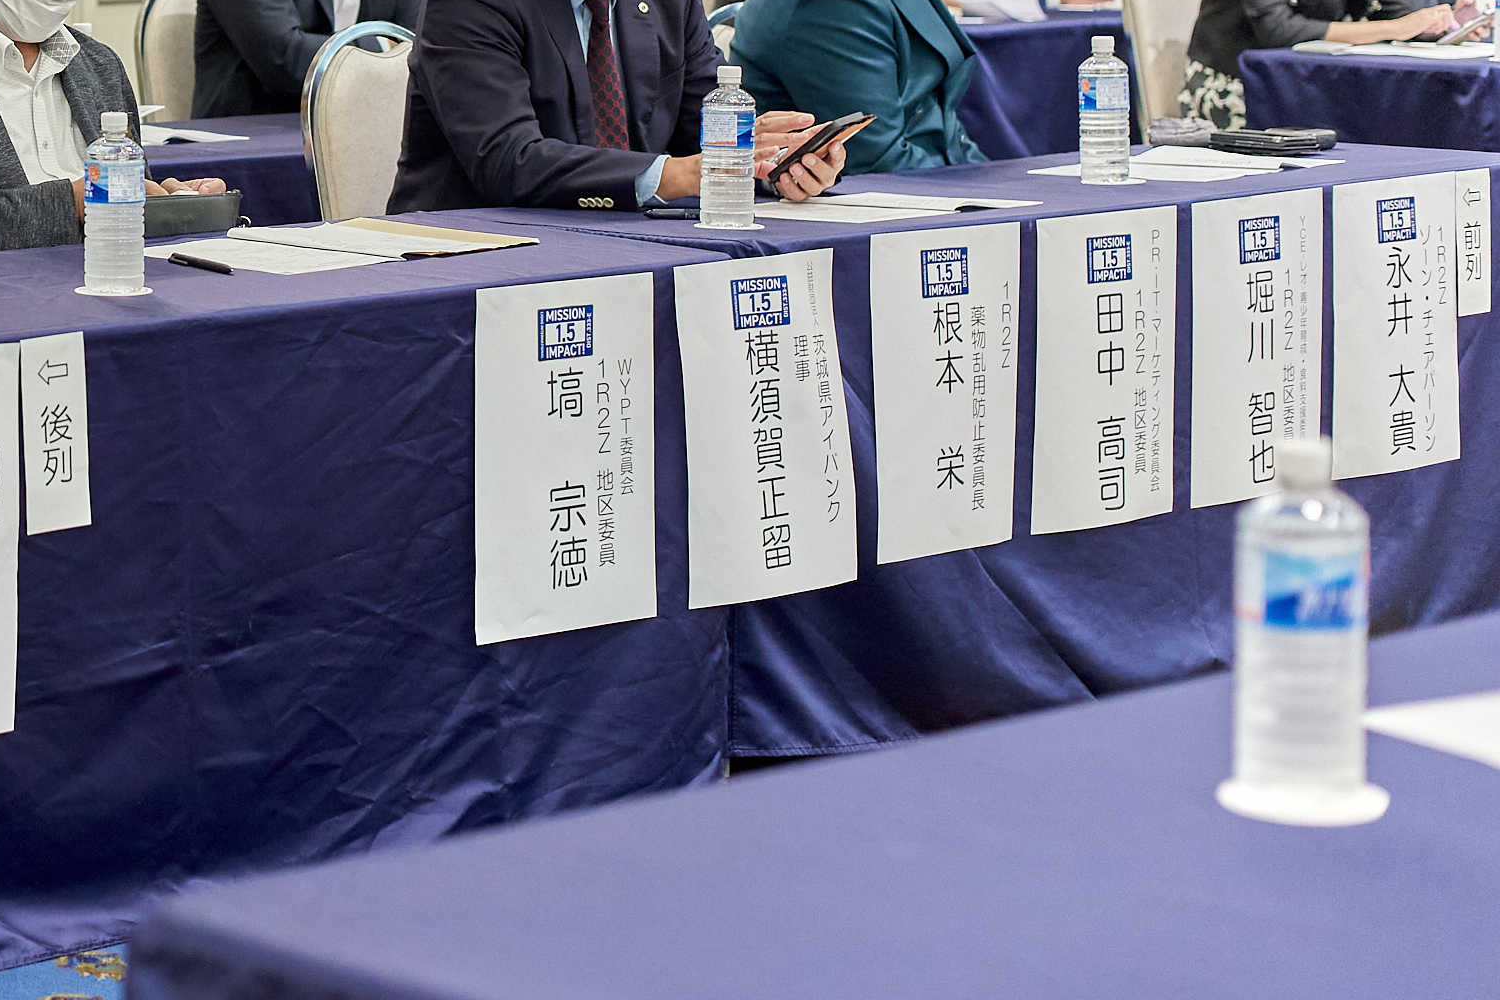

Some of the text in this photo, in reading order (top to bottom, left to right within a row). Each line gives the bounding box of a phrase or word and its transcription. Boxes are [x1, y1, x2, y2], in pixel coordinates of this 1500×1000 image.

[1381, 199, 1410, 211] MISSION
[1389, 212, 1404, 228] 1.5
[1244, 218, 1275, 231] MISSION
[1252, 231, 1267, 249] 1.5
[1383, 229, 1412, 242] IMPACT!
[928, 249, 961, 262] MISSION
[1093, 236, 1126, 249] MISSION
[1102, 250, 1117, 267] 1.5
[1245, 249, 1275, 263] IMPACT!
[1463, 220, 1482, 282] 前列
[936, 263, 953, 282] 1.5
[1094, 268, 1126, 282] IMPACT!
[1437, 226, 1447, 305] 1R2Z
[738, 277, 781, 292] MISSION
[929, 283, 962, 296] IMPACT!
[546, 307, 586, 322] MISSION
[749, 292, 771, 312] 1.5
[556, 322, 575, 342] 1.5
[740, 312, 783, 328] IMPACT!
[1001, 281, 1012, 369] 1R2Z
[546, 343, 586, 359] IMPACT!
[1283, 268, 1295, 442] 1R2Z 地区委員
[1386, 247, 1416, 456] 永井 大貴
[1419, 225, 1436, 452] ゾーン・チェアパーソン
[793, 335, 810, 381] 理事
[1134, 289, 1147, 475] 1R2Z 地区委員
[1246, 270, 1276, 484] 堀川 智也
[933, 301, 964, 490] 根本 栄
[970, 306, 986, 511] 薬物乱用防止委員長
[1097, 292, 1126, 512] 田中 高司
[617, 358, 634, 495] WYPT委員会
[813, 334, 841, 523] 茨城県アイバンク
[40, 403, 73, 486] 後列
[745, 330, 792, 570] 横須賀正留
[547, 366, 588, 591] 塙 宗徳
[596, 358, 615, 567] 1R2Z 地区委員
